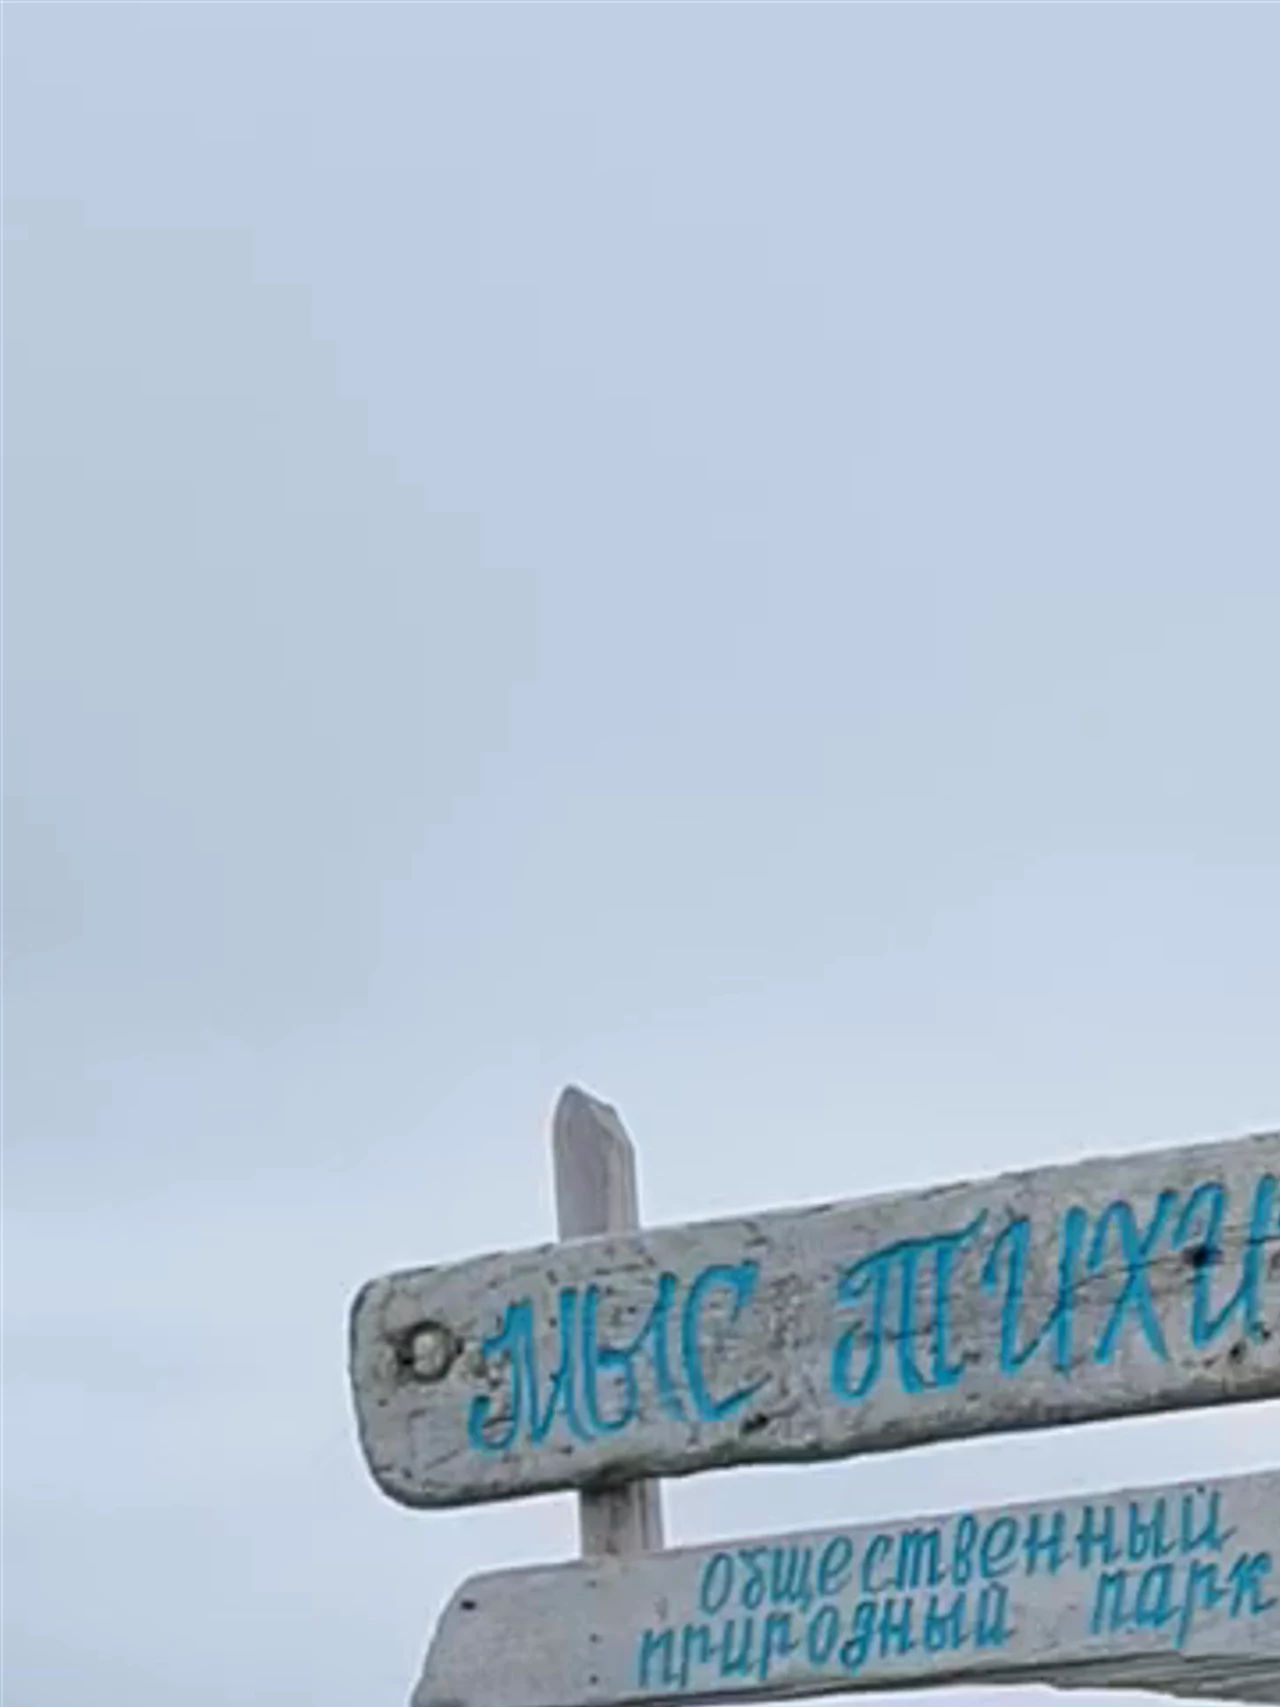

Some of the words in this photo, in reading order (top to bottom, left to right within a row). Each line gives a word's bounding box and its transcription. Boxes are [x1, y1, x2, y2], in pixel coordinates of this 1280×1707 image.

[468, 1258, 771, 1450] МЫС
[638, 1580, 1016, 1690] природный
[1088, 1551, 1278, 1650] парк
